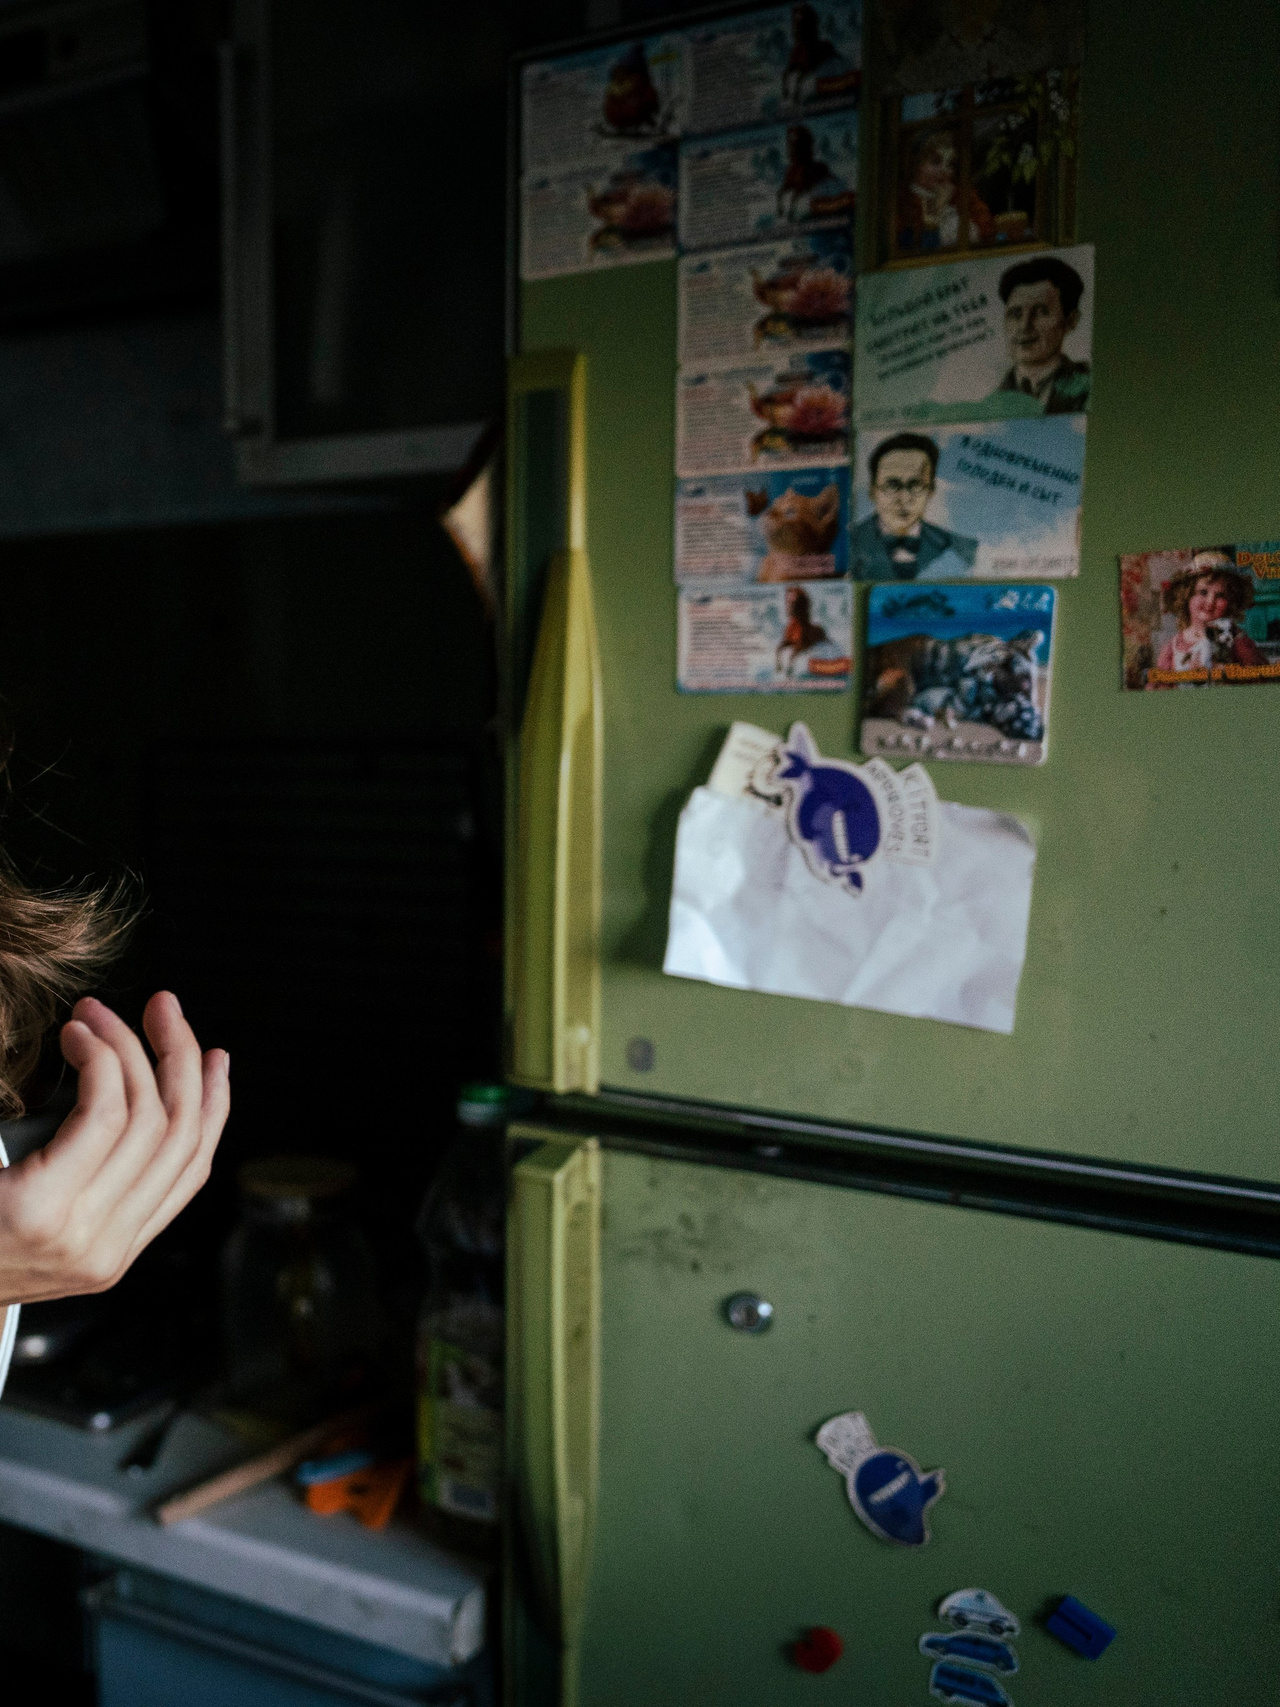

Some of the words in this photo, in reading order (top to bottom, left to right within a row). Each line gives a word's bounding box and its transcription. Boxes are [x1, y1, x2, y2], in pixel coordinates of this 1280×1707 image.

[957, 457, 1016, 489] ГОЛОДЕН
[1031, 486, 1062, 507] СЫТ
[971, 439, 1079, 485] ОДНОВРЕМЕННО
